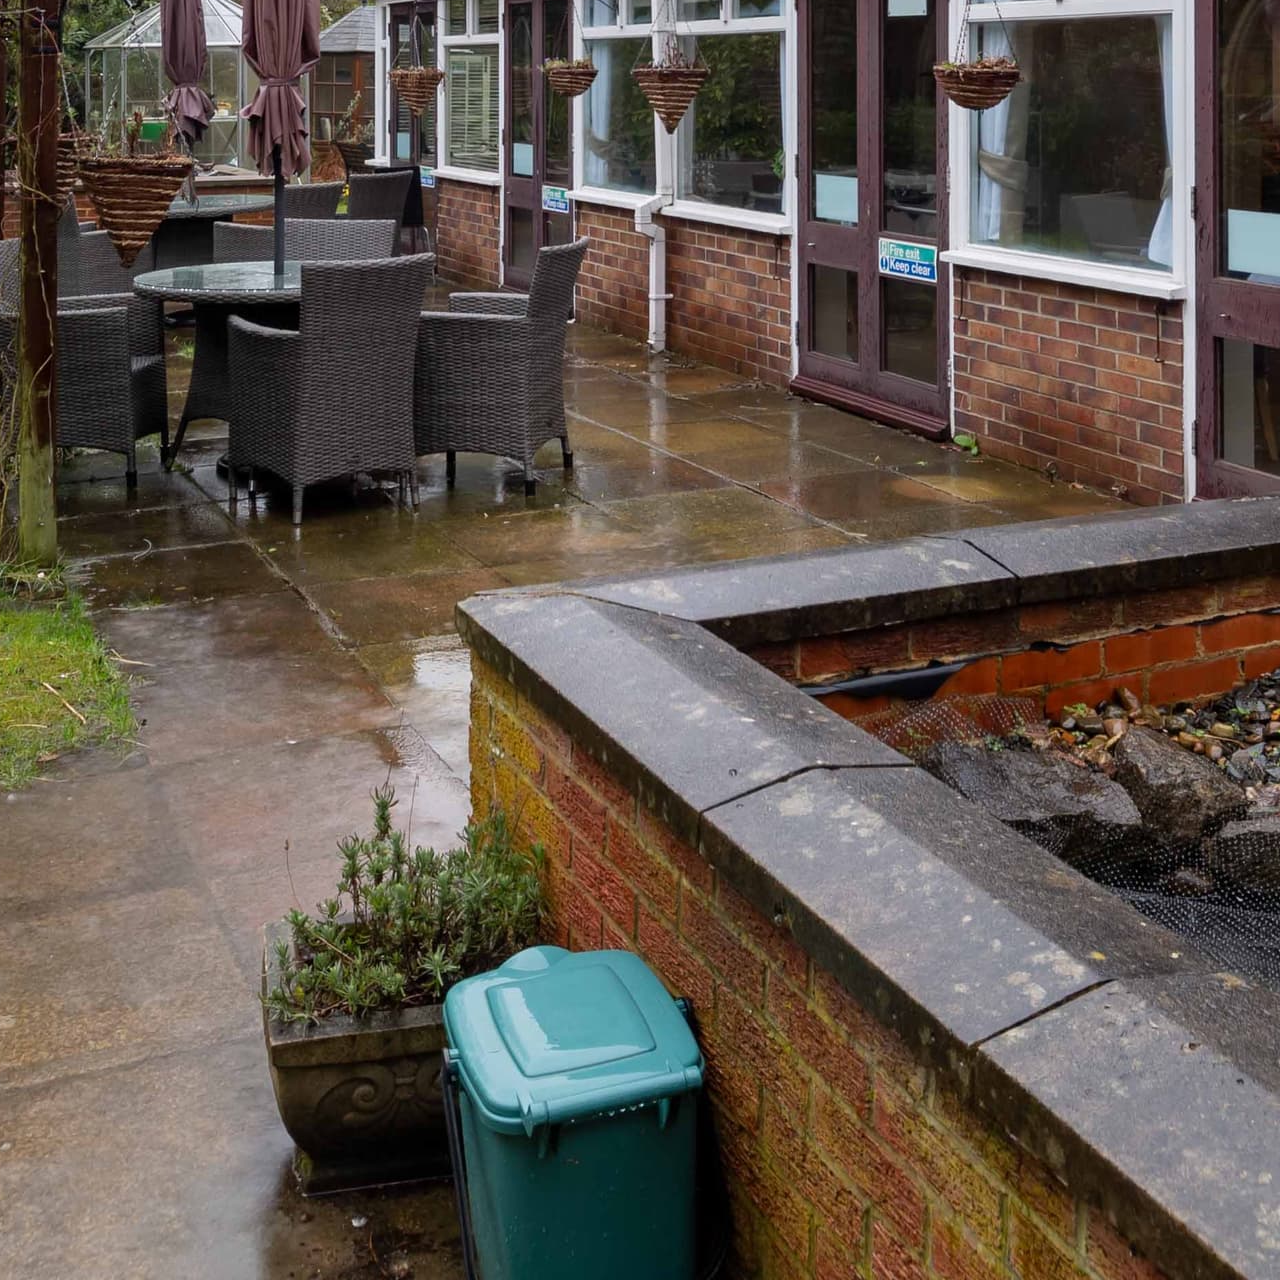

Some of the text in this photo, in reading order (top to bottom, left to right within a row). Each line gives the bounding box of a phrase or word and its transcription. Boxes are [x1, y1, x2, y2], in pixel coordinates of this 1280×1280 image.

[890, 244, 920, 260] Fire exit
[890, 257, 930, 276] Keep clear
